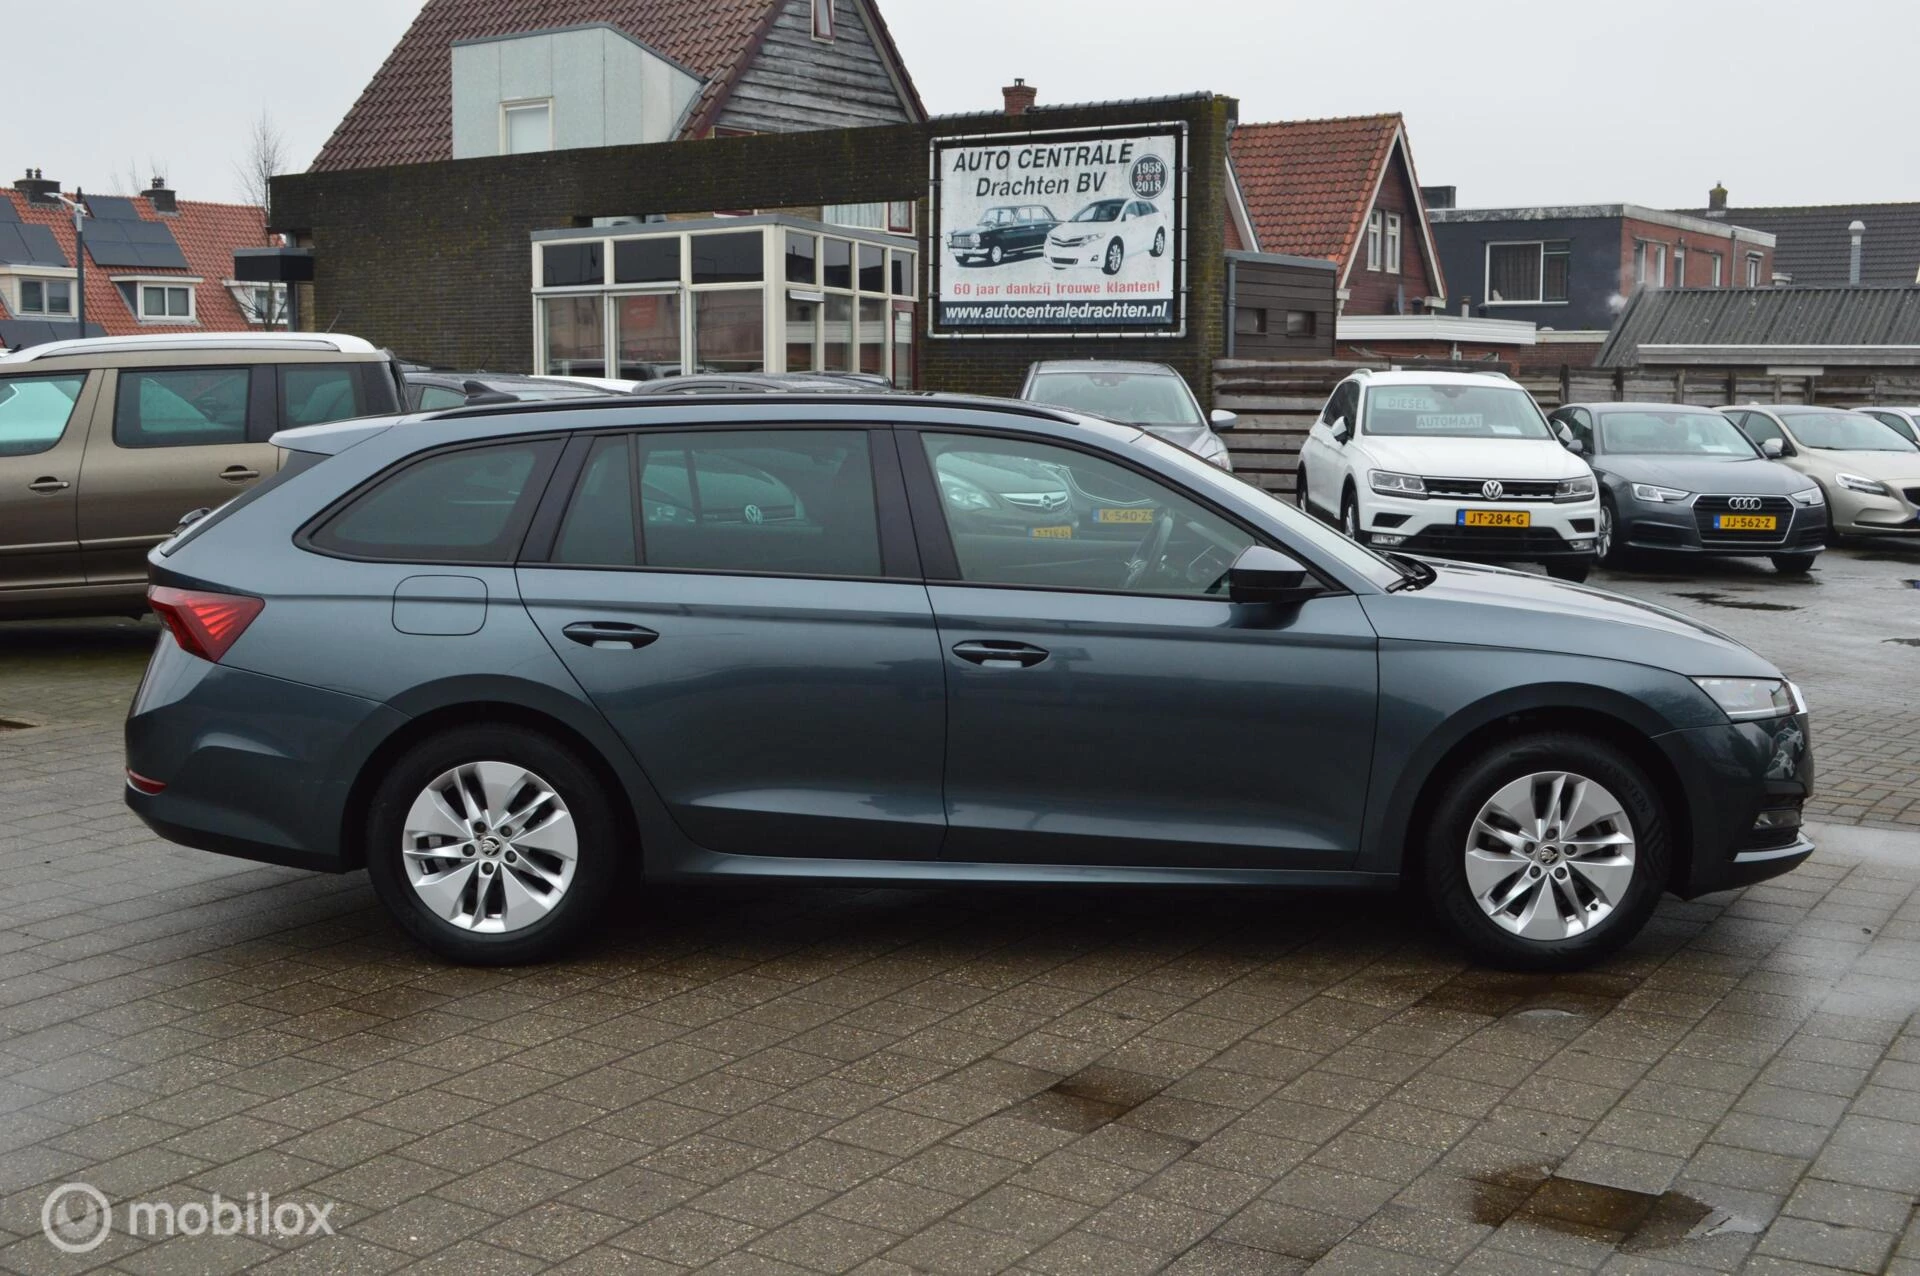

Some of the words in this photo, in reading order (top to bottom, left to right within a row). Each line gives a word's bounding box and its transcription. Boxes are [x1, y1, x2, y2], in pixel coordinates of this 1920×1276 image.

[953, 150, 1011, 172] AUTO
[1018, 143, 1134, 169] CENTRALE
[1136, 162, 1162, 174] 1958
[976, 175, 1070, 197] Drachten
[1076, 172, 1106, 193] BV
[1135, 180, 1162, 192] 2018
[954, 283, 970, 295] 60
[976, 283, 1000, 296] jaar
[1006, 282, 1050, 296] dankzij
[1056, 282, 1100, 294] trouwe
[1106, 280, 1160, 293] klanten!
[945, 301, 1167, 319] www.autocentraledrachten.nl
[1388, 398, 1429, 409] DIESEL
[1418, 415, 1481, 426] AUTOMAAT
[1469, 513, 1524, 525] JT-284-G
[1725, 518, 1770, 528] JJ-562-Z
